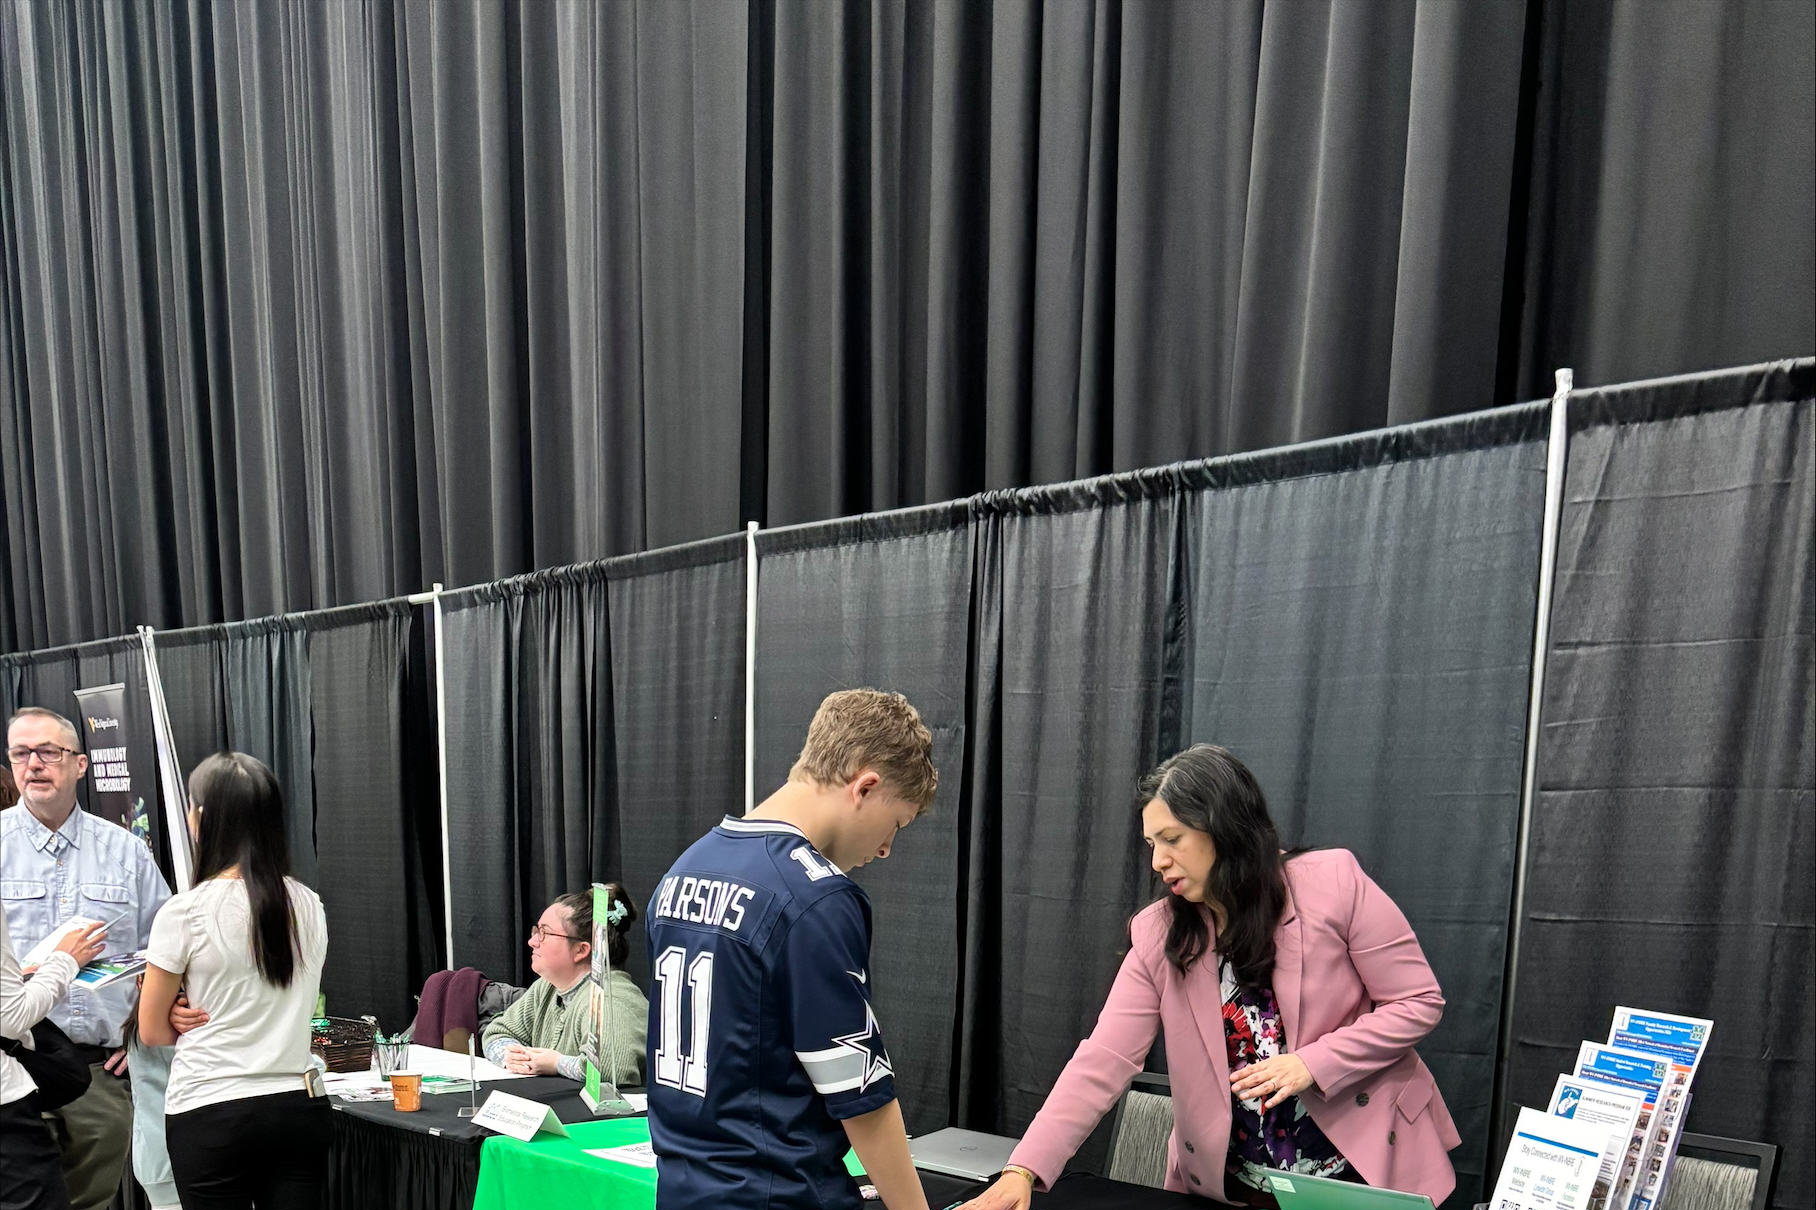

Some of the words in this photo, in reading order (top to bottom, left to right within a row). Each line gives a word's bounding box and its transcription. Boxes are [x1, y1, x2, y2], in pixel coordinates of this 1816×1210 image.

[90, 747, 126, 764] IMMUNOLOGY
[94, 764, 106, 778] AND
[106, 762, 130, 777] MEDICAL
[95, 777, 131, 792] MICROBIOLOGY
[655, 876, 755, 932] PARSONS
[654, 945, 714, 1099] 11
[1522, 1144, 1531, 1156] Stay
[1531, 1146, 1550, 1160] Connected
